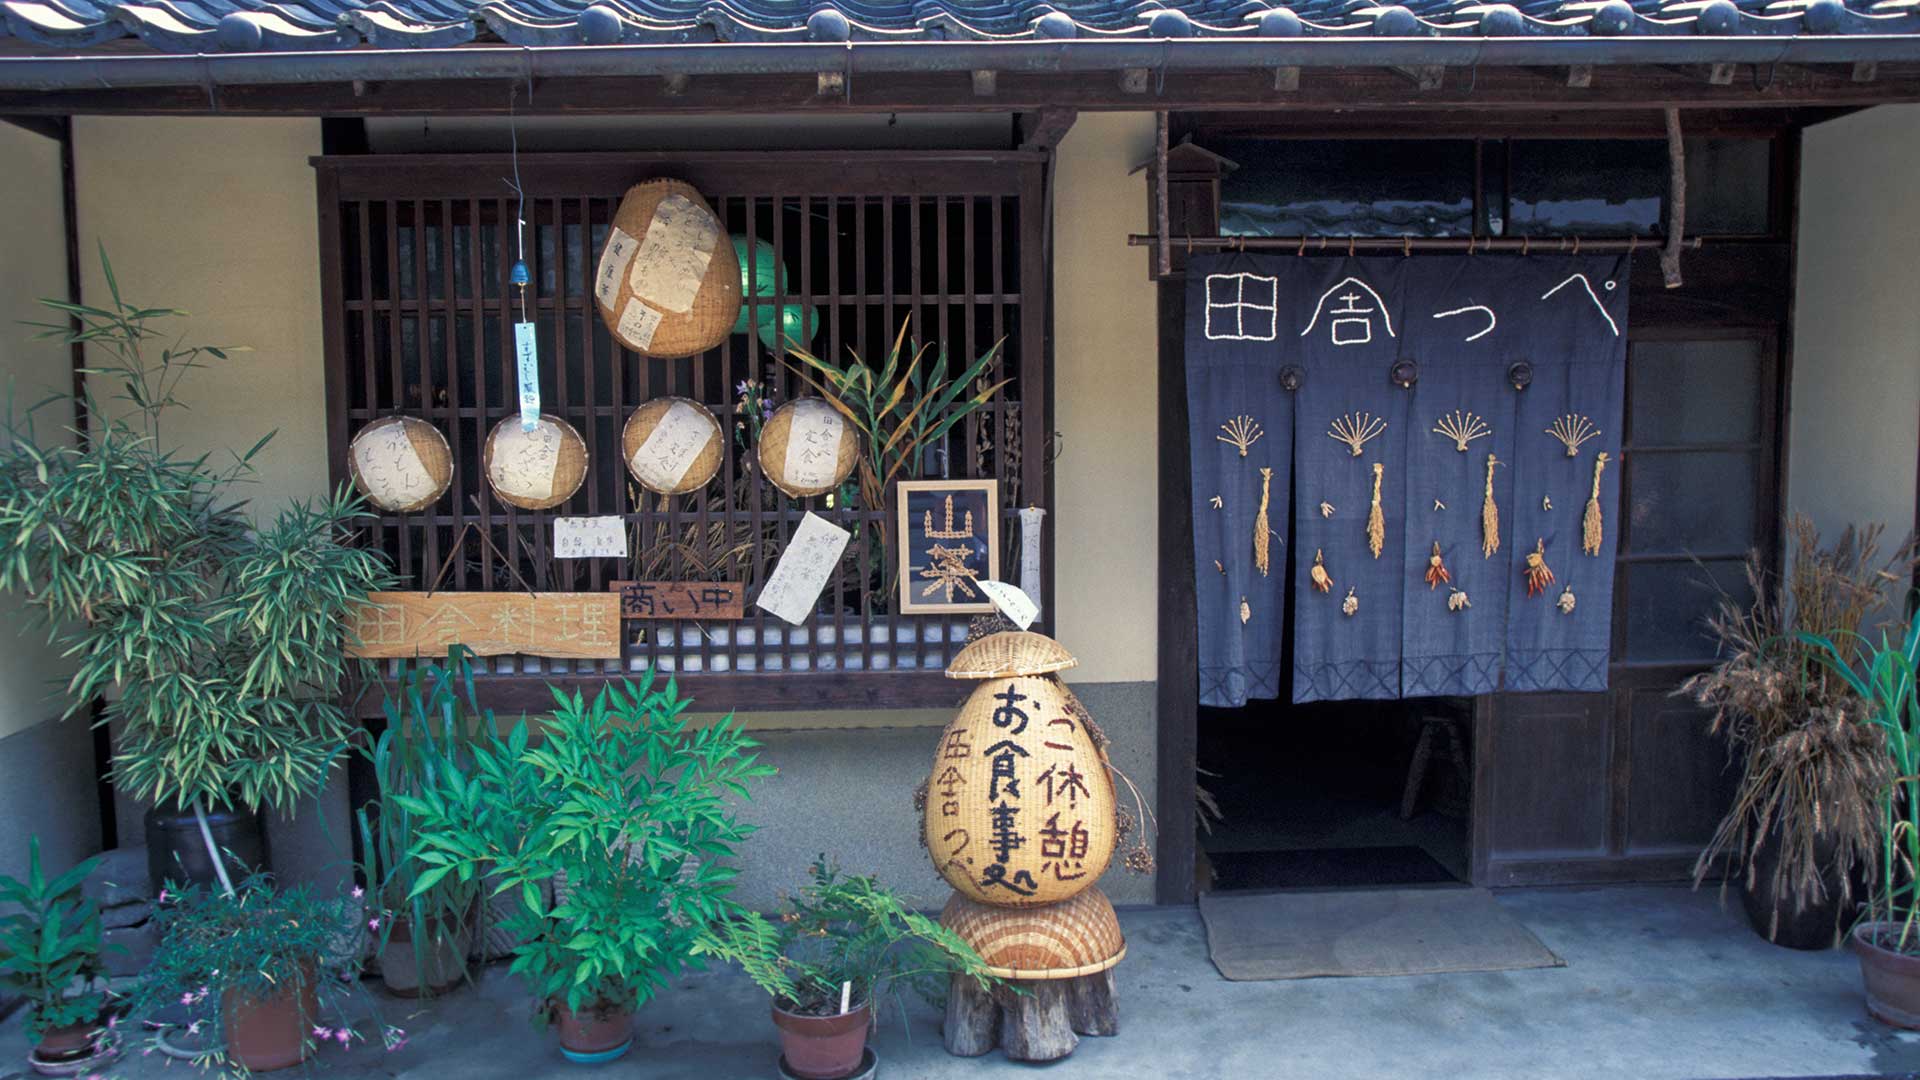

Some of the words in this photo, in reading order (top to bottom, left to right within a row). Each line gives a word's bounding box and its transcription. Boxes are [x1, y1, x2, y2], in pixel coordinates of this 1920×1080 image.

[622, 583, 733, 615] 商い中
[357, 602, 612, 646] 田舎料理
[980, 683, 1041, 896] お食事処
